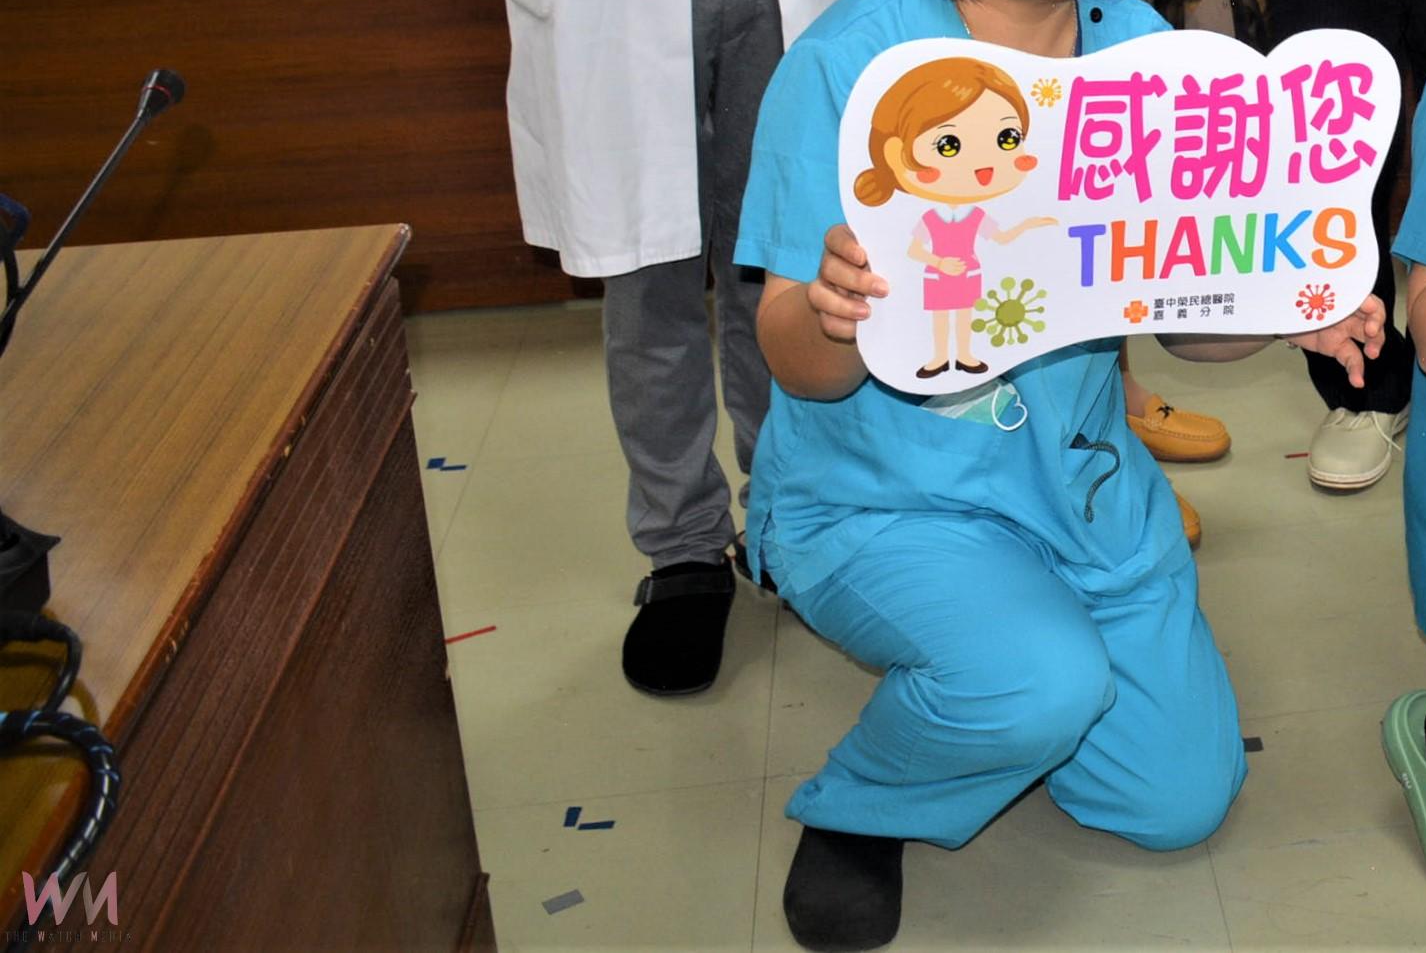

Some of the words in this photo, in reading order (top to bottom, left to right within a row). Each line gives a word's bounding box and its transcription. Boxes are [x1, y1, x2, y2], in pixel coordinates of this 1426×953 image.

[1057, 59, 1378, 203] 感謝您
[1067, 207, 1357, 287] THANKS
[1154, 293, 1235, 309] 臺中榮民總醫院
